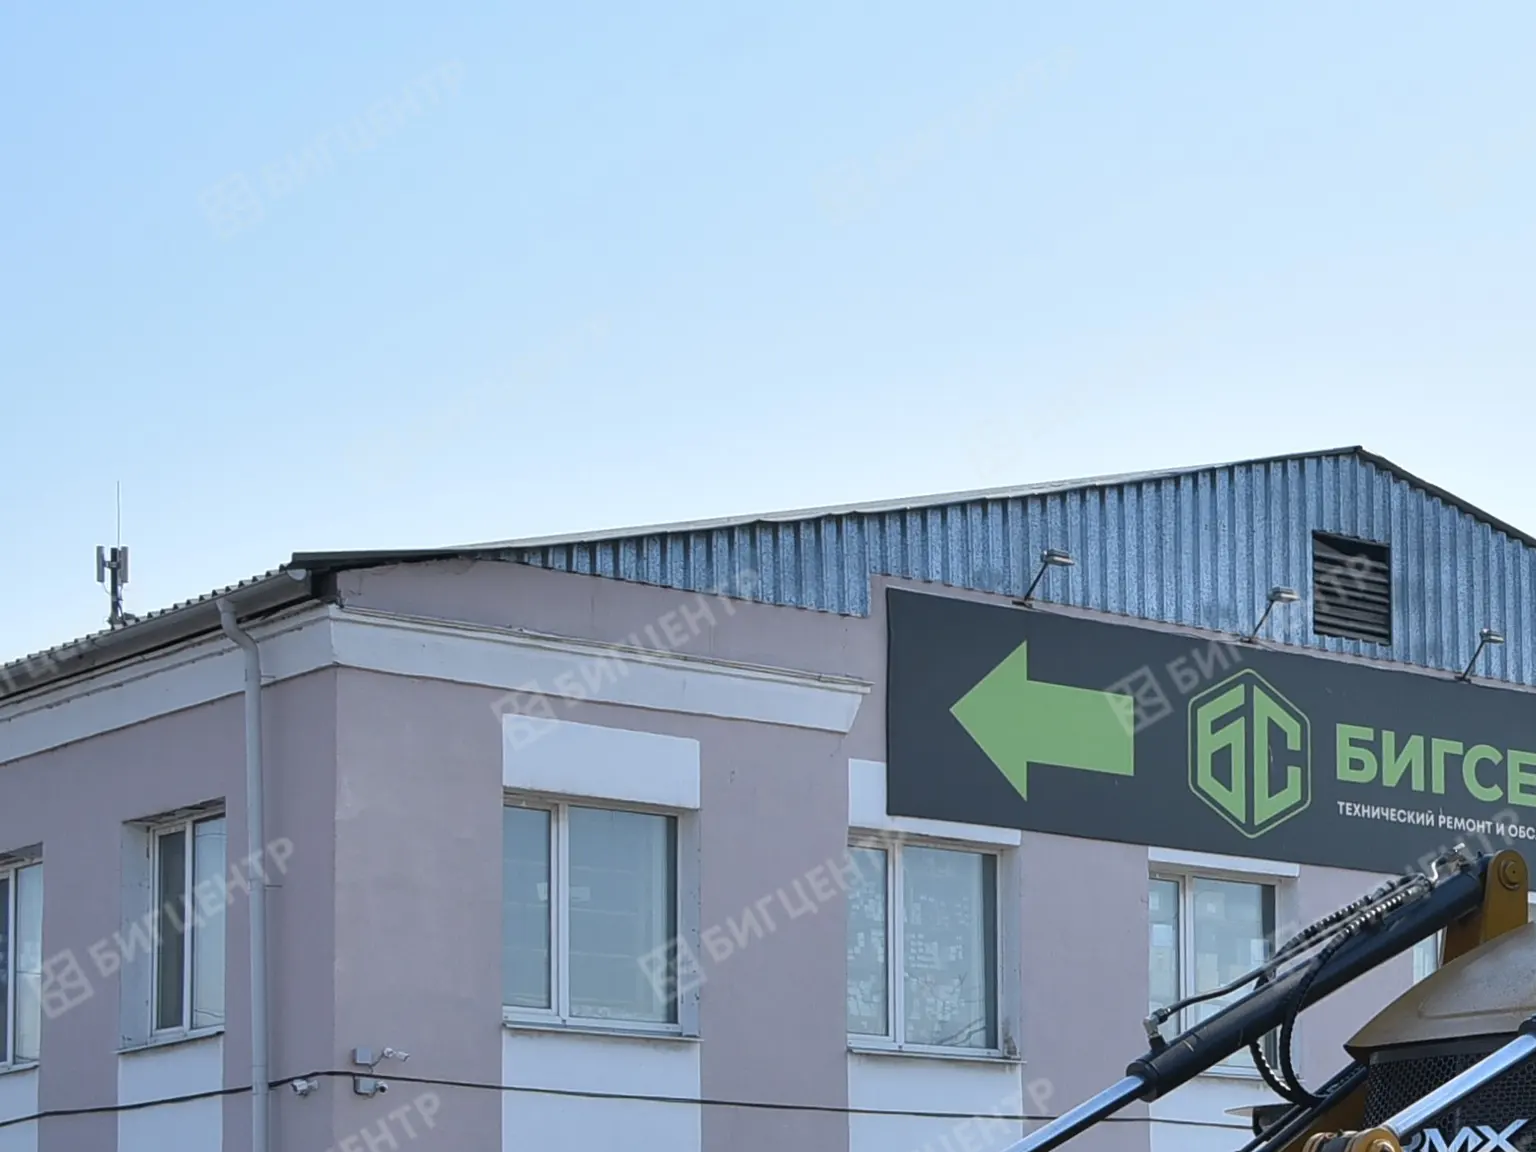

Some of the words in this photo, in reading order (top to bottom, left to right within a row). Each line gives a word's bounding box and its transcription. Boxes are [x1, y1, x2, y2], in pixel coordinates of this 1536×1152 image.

[1337, 801, 1435, 827] ТЕХНИЧЕСКИЙ
[1438, 815, 1493, 834] РЕМОНТ
[1495, 822, 1505, 835] И
